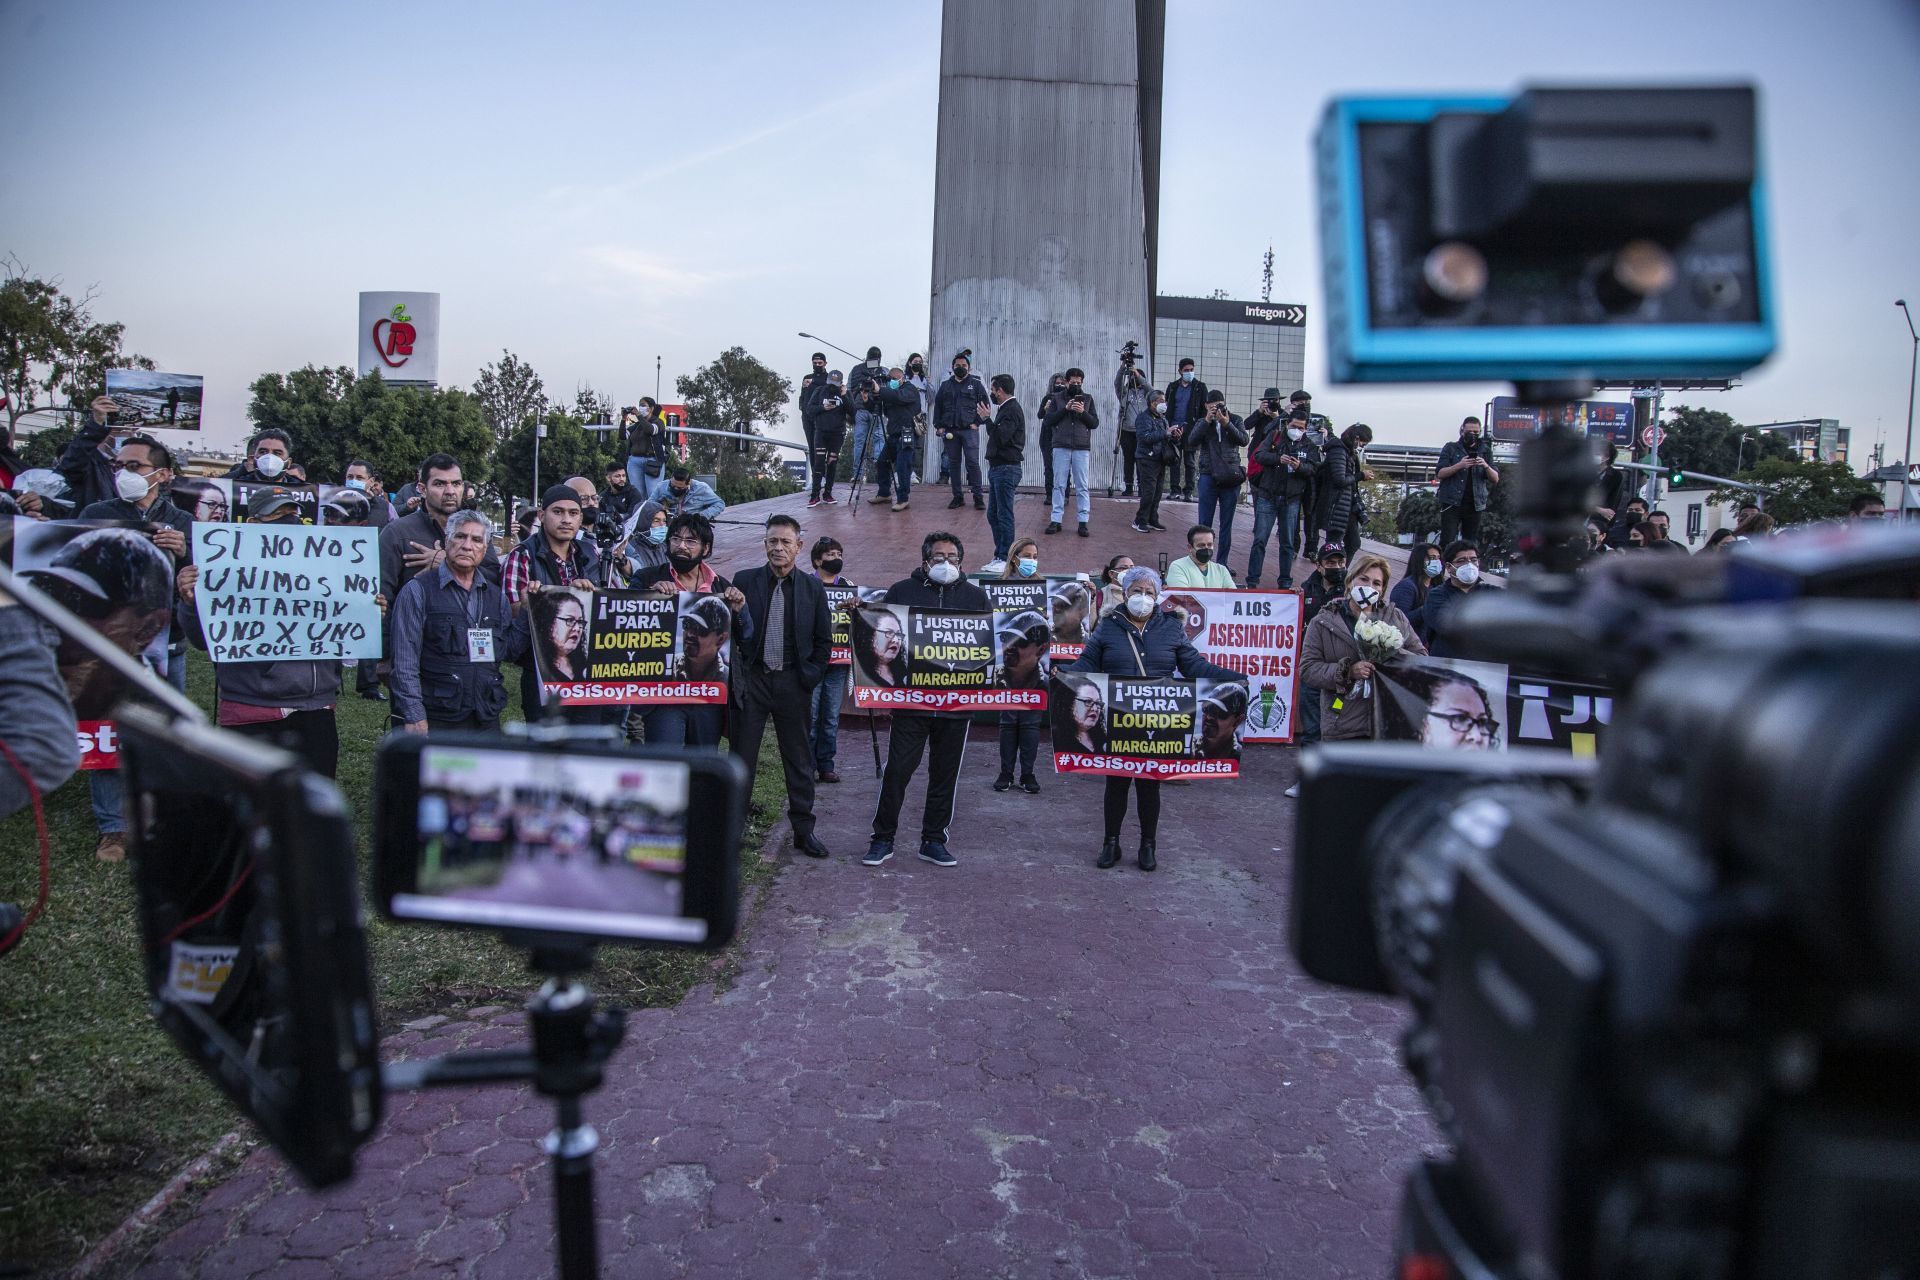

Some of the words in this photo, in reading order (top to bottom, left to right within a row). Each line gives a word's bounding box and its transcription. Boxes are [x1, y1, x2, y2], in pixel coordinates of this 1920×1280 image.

[1245, 305, 1286, 321] Integon
[261, 534, 294, 559] NO
[303, 534, 368, 564] NOS
[204, 566, 332, 597] UNIMOS
[344, 573, 379, 596] NOS
[210, 595, 349, 621] MATARAN
[598, 596, 675, 620] ¡JUSTICIA
[998, 596, 1035, 606] PARA
[1232, 601, 1243, 616] A
[1245, 601, 1272, 617] LOS
[615, 615, 661, 629] PARA
[915, 613, 990, 634] ¡JUSTICIA
[275, 621, 299, 645] X
[307, 622, 366, 643] UNO
[594, 631, 672, 650] LOURDES
[932, 630, 977, 645] PARA
[1208, 623, 1295, 650] ASESINATOS
[213, 642, 302, 662] PARQUE
[626, 651, 636, 662] Y
[914, 645, 991, 661] LOURDES
[591, 653, 674, 678] MARGARITO!
[911, 664, 994, 686] MARGARITO!
[947, 662, 955, 671] Y
[858, 688, 1041, 706] #YoSíSoyPeriodista
[1115, 682, 1192, 702] ¡JUSTICIA
[1132, 699, 1180, 711] PARA
[1113, 714, 1191, 729] LOURDES
[1111, 734, 1193, 754] MARGARITO!
[1146, 730, 1155, 740] Y
[1058, 754, 1233, 774] #YoSíSoyPeriodista
